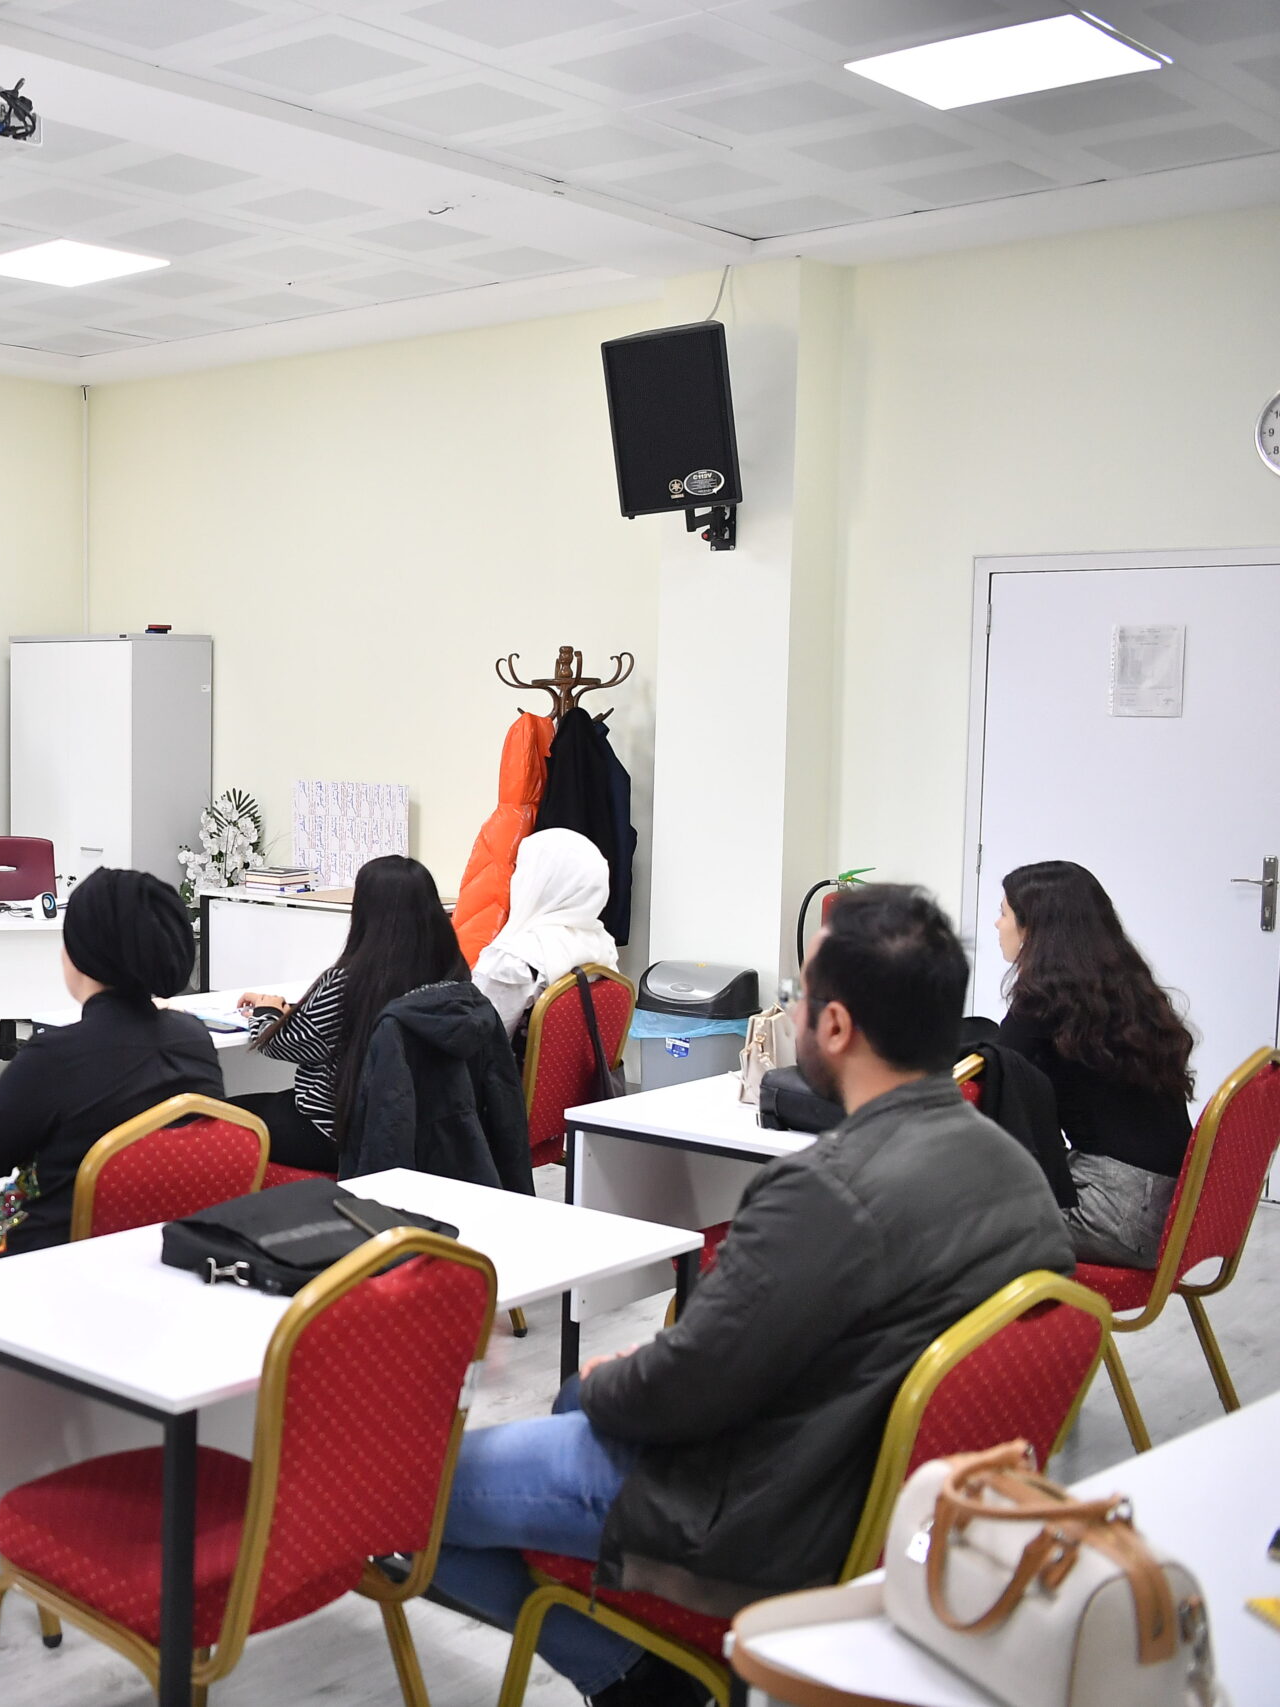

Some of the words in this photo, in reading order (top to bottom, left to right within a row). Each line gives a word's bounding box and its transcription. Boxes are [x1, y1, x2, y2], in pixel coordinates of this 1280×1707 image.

[1274, 410, 1280, 419] 1
[1268, 428, 1274, 437] 9
[1273, 446, 1279, 455] 8
